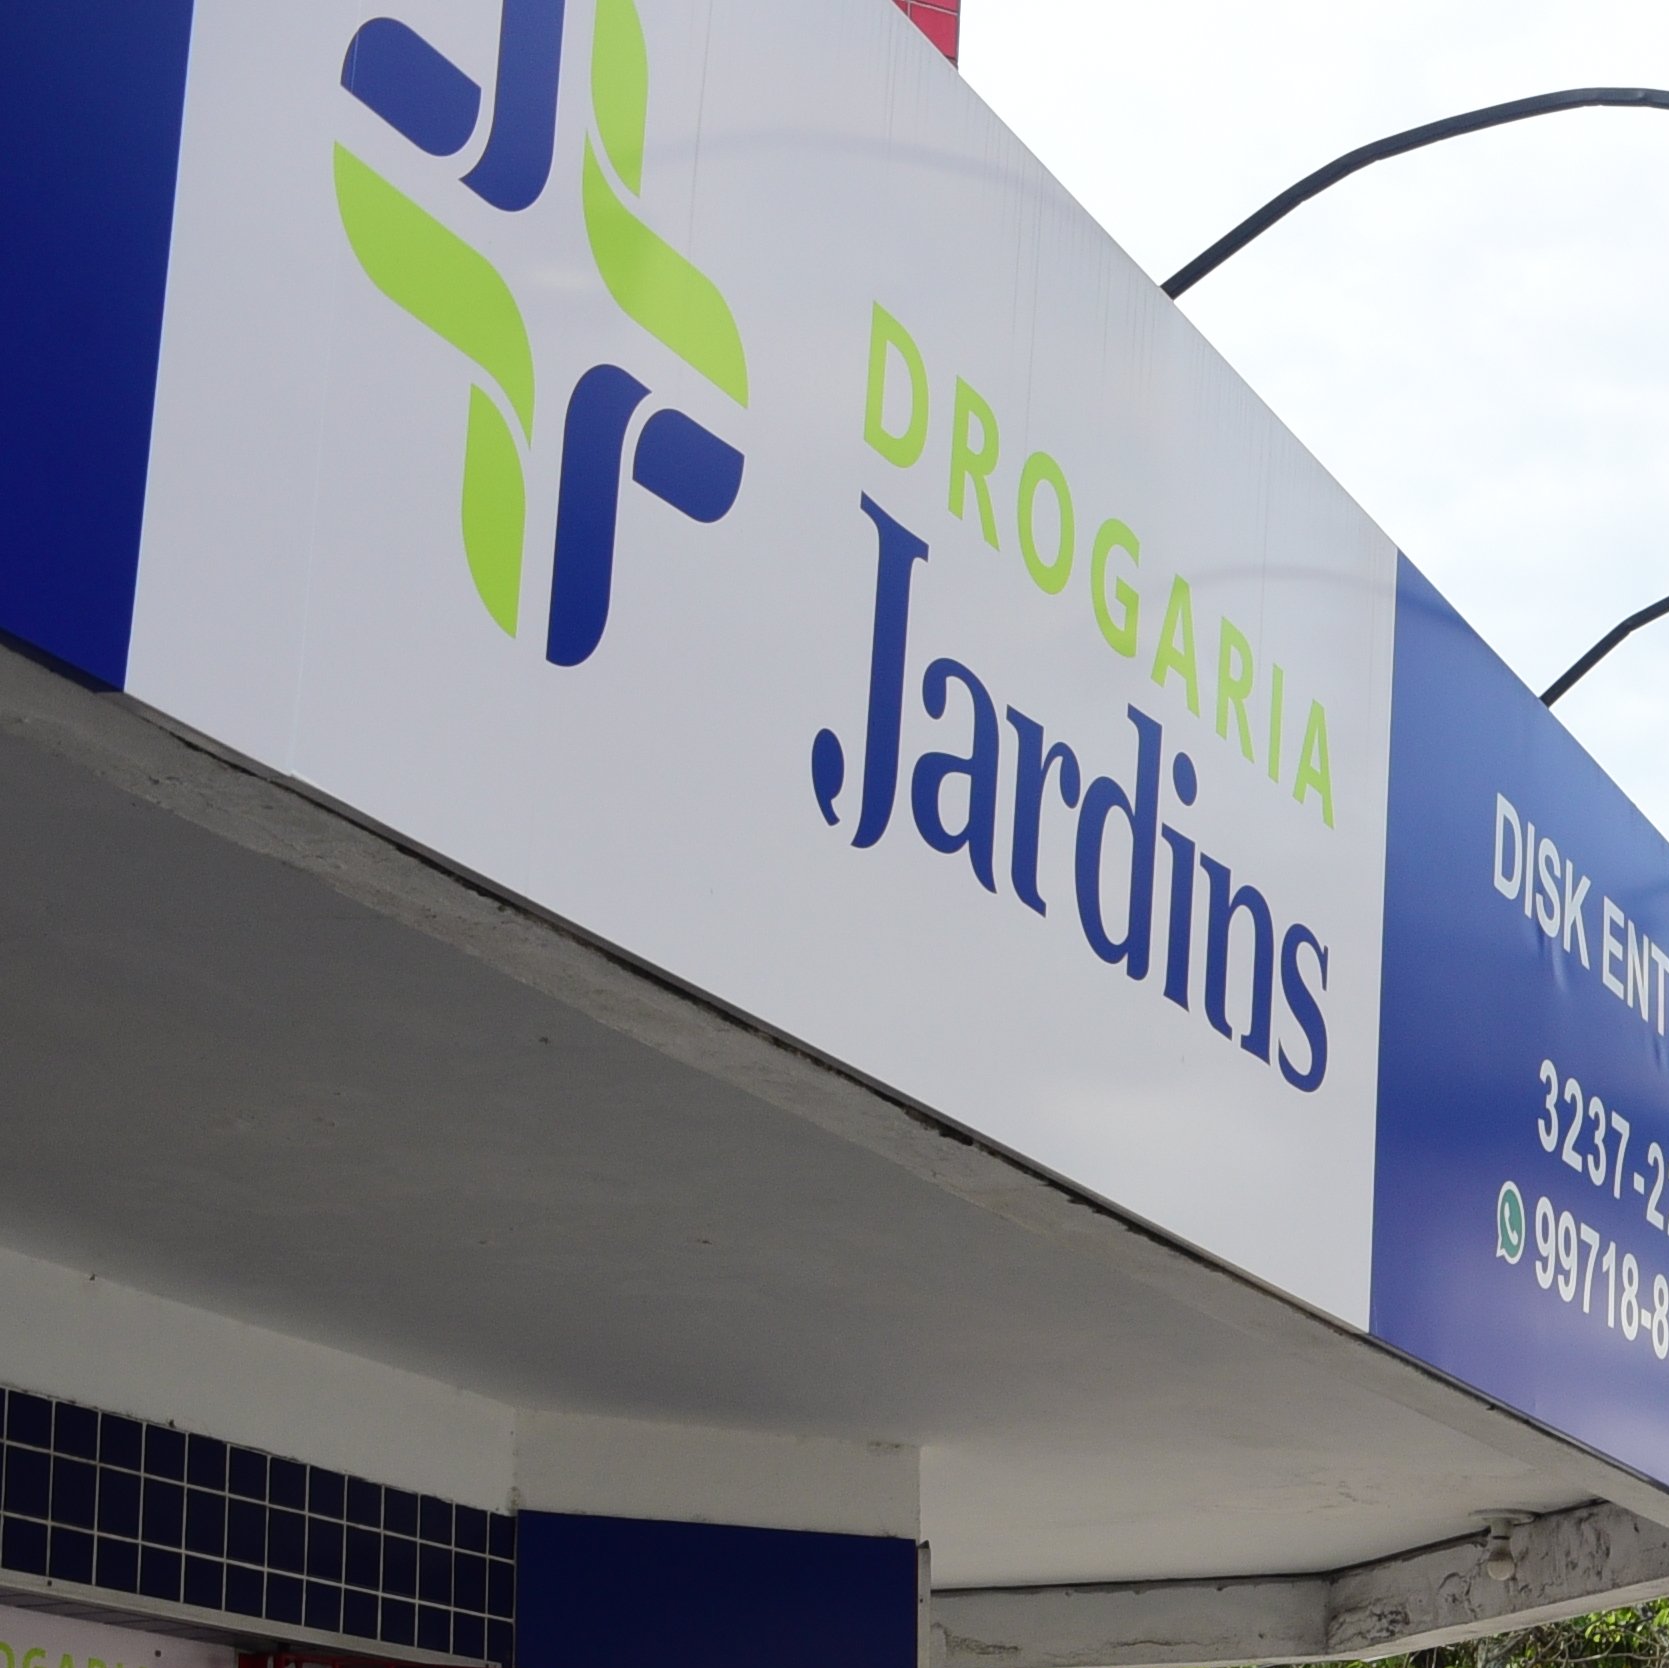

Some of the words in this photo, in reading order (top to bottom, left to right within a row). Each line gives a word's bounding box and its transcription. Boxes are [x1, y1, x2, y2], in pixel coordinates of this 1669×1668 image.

[811, 490, 1329, 1094] Jardins
[862, 300, 1336, 830] DROGARIA
[1494, 792, 1591, 970] DISK
